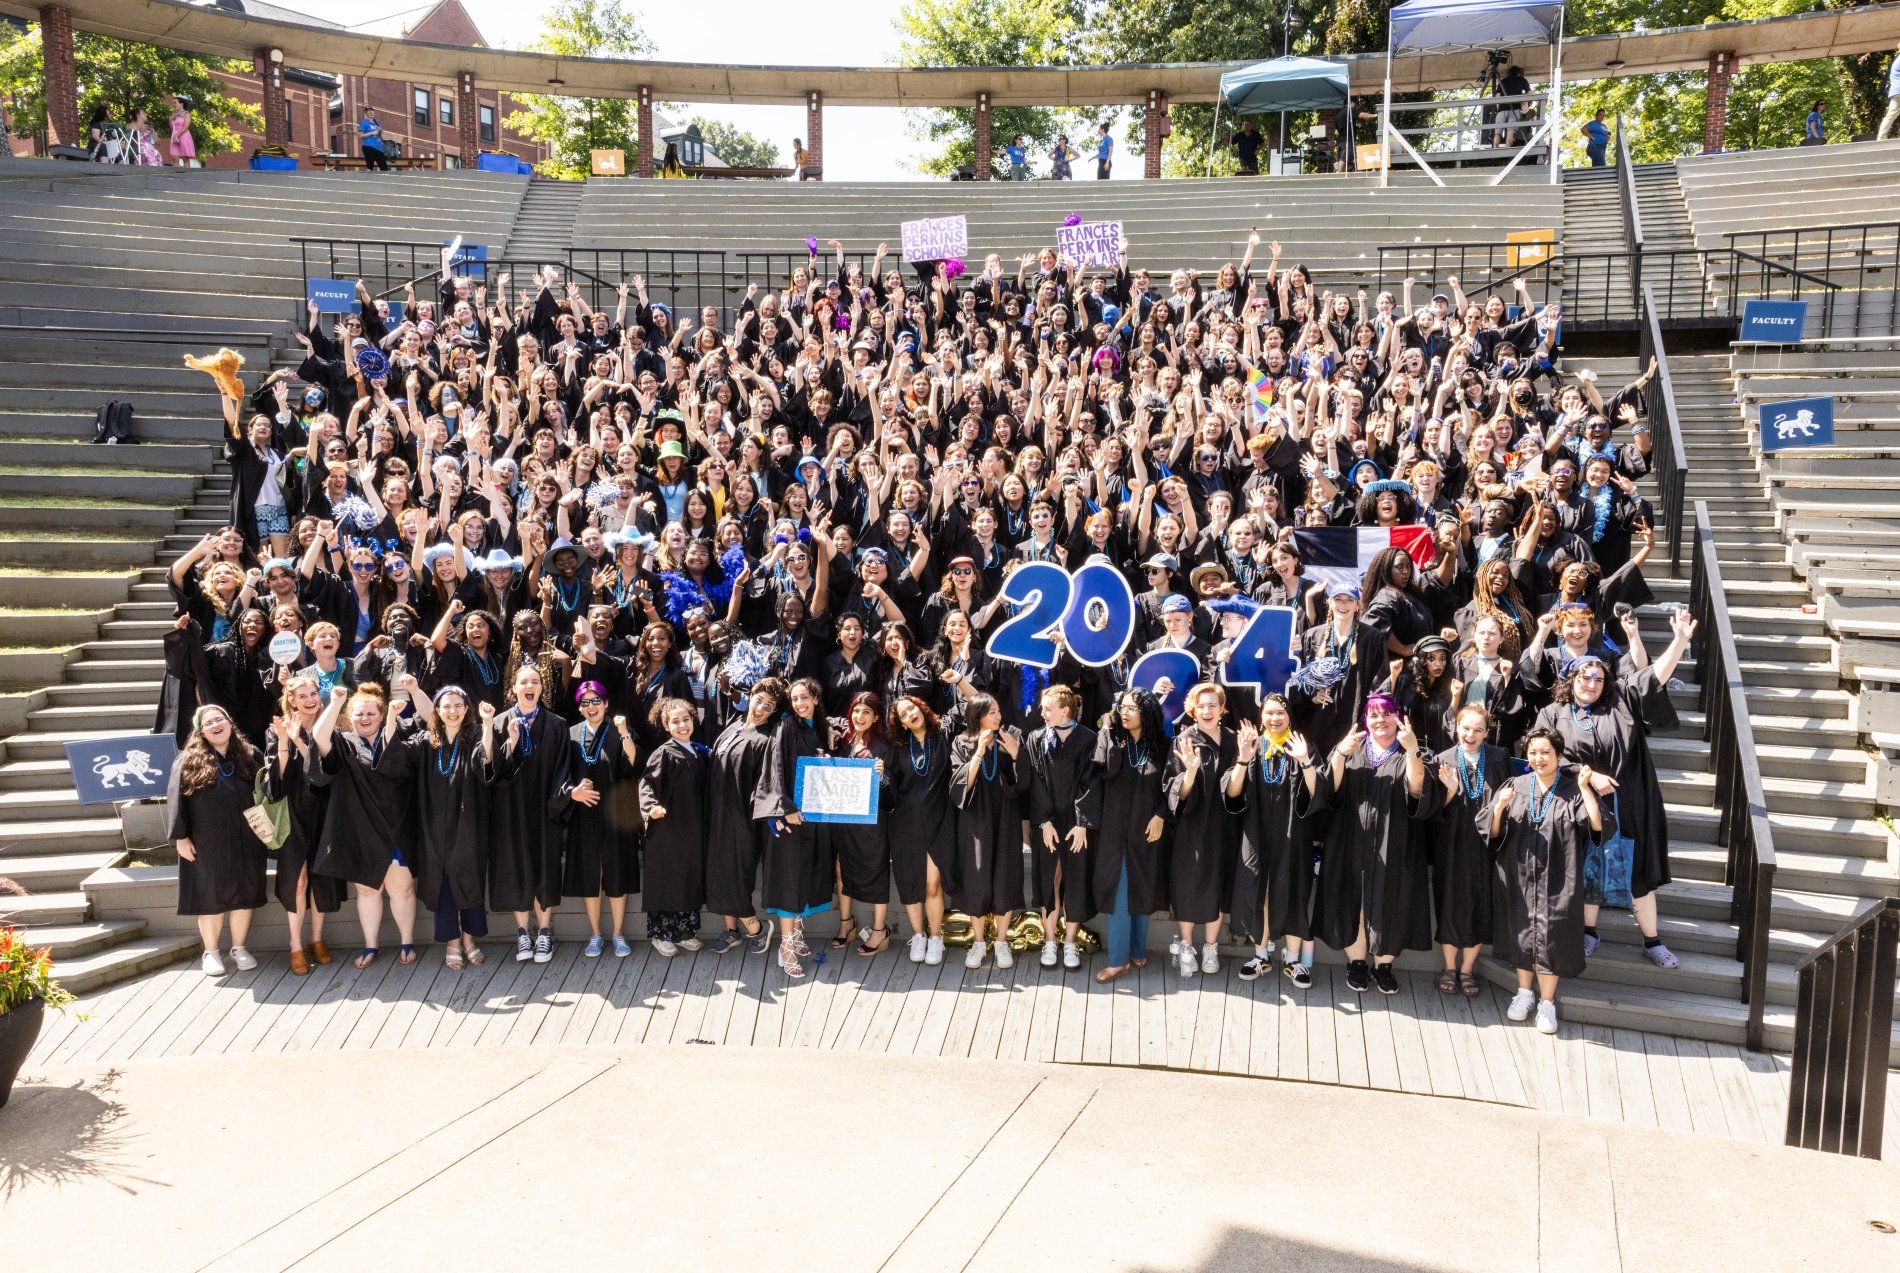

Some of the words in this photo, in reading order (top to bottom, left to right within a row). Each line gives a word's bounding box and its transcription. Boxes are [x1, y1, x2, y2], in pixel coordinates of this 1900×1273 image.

[903, 218, 964, 235] FRANCES
[1057, 223, 1119, 243] FRANCES
[903, 231, 963, 248] PERKINS
[1059, 237, 1120, 256] PERKINS
[904, 243, 967, 260] SCHOLARS
[315, 291, 349, 299] FACULTY
[1752, 317, 1797, 325] FACULTY
[810, 767, 860, 783] CLASS
[809, 783, 861, 798] BOARD
